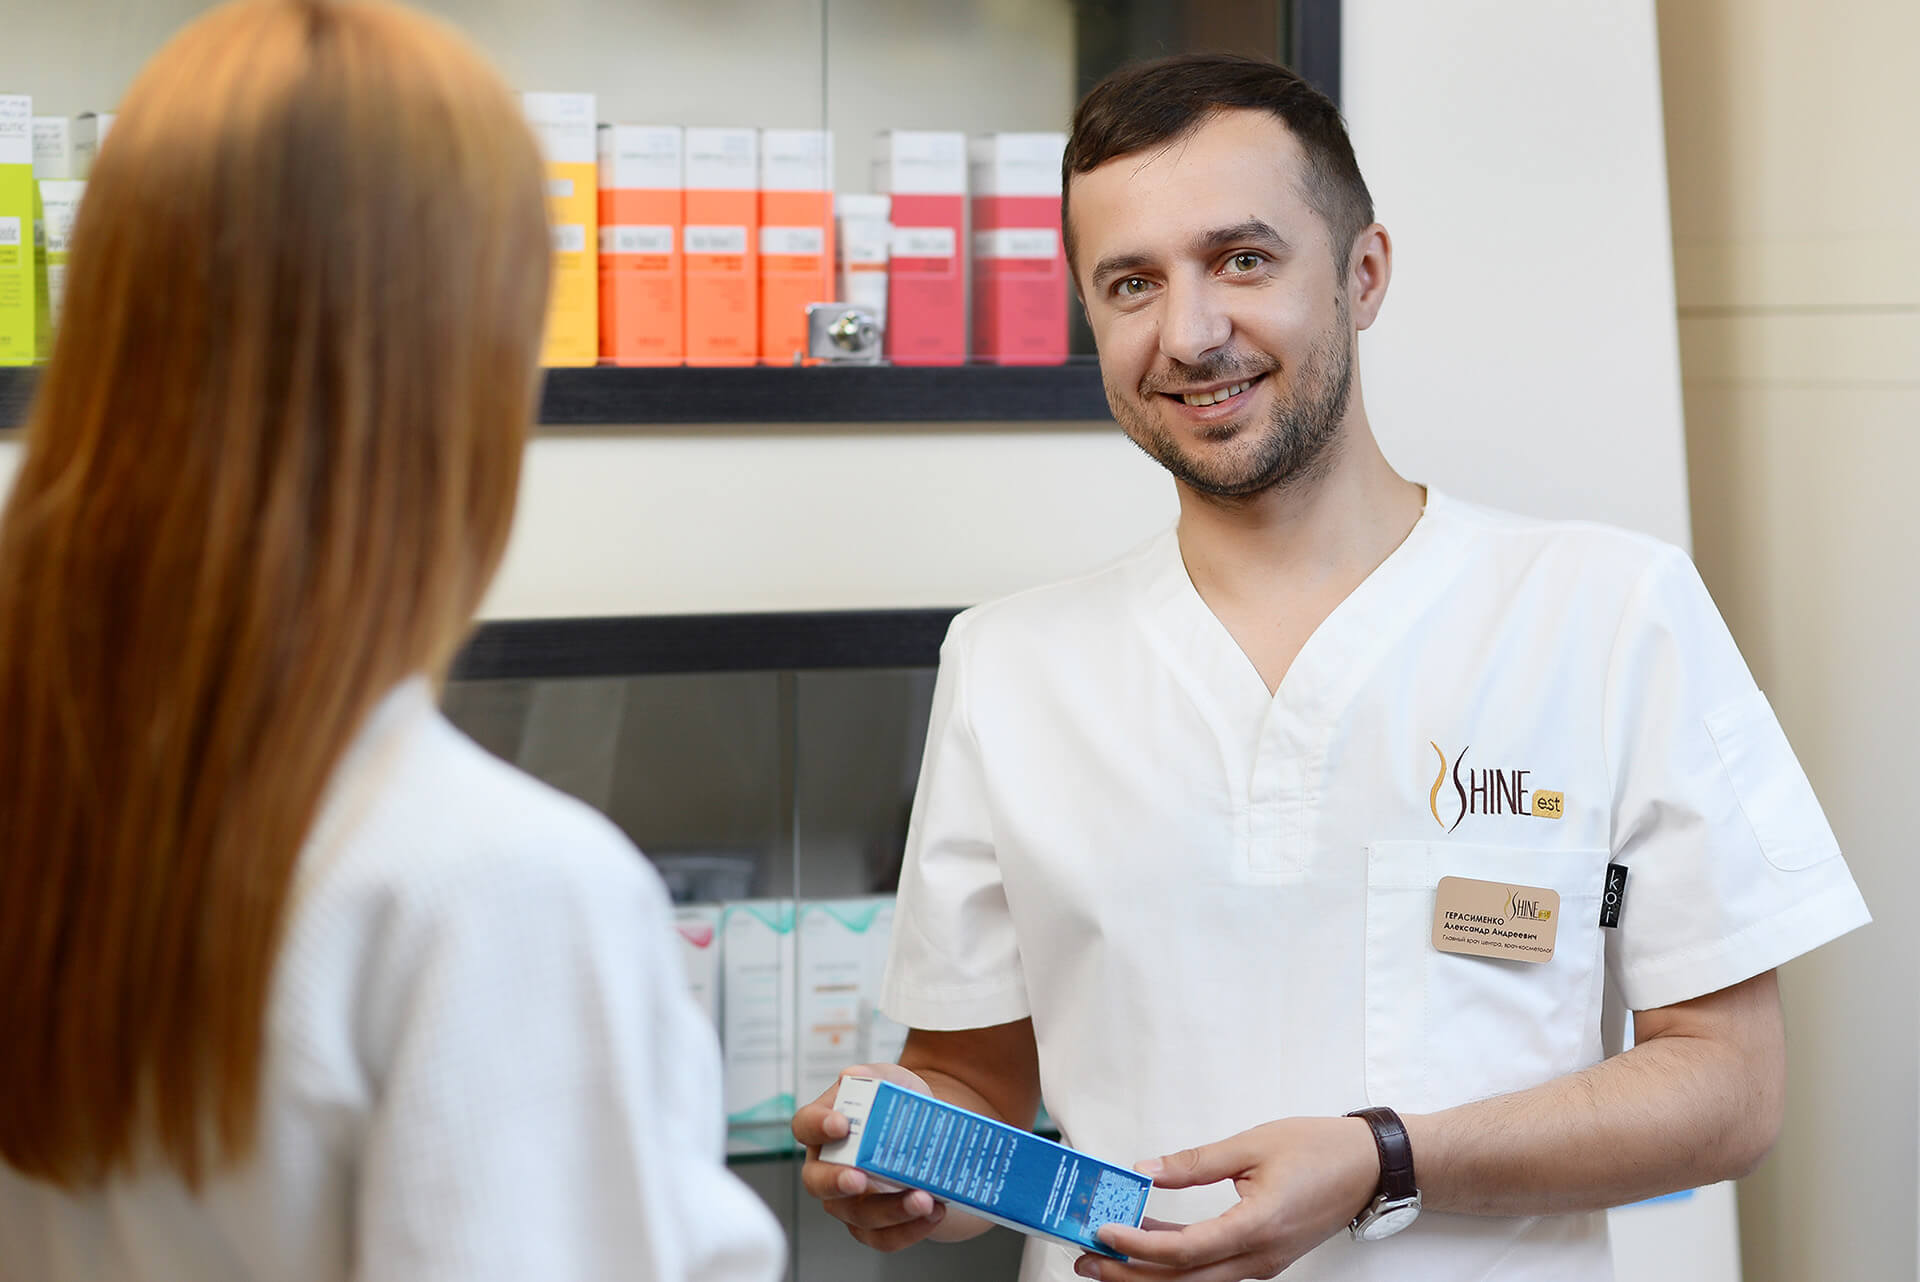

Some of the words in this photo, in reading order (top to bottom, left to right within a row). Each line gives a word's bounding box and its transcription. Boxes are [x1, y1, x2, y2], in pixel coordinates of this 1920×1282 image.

[1448, 745, 1531, 834] SHINE
[1537, 797, 1561, 812] est
[1509, 890, 1540, 920] SHINE
[1445, 911, 1505, 926] ГЕРАСИМЕНКО
[1442, 934, 1466, 943] Главный
[1444, 922, 1490, 935] Александр
[1492, 928, 1537, 941] Андреевич
